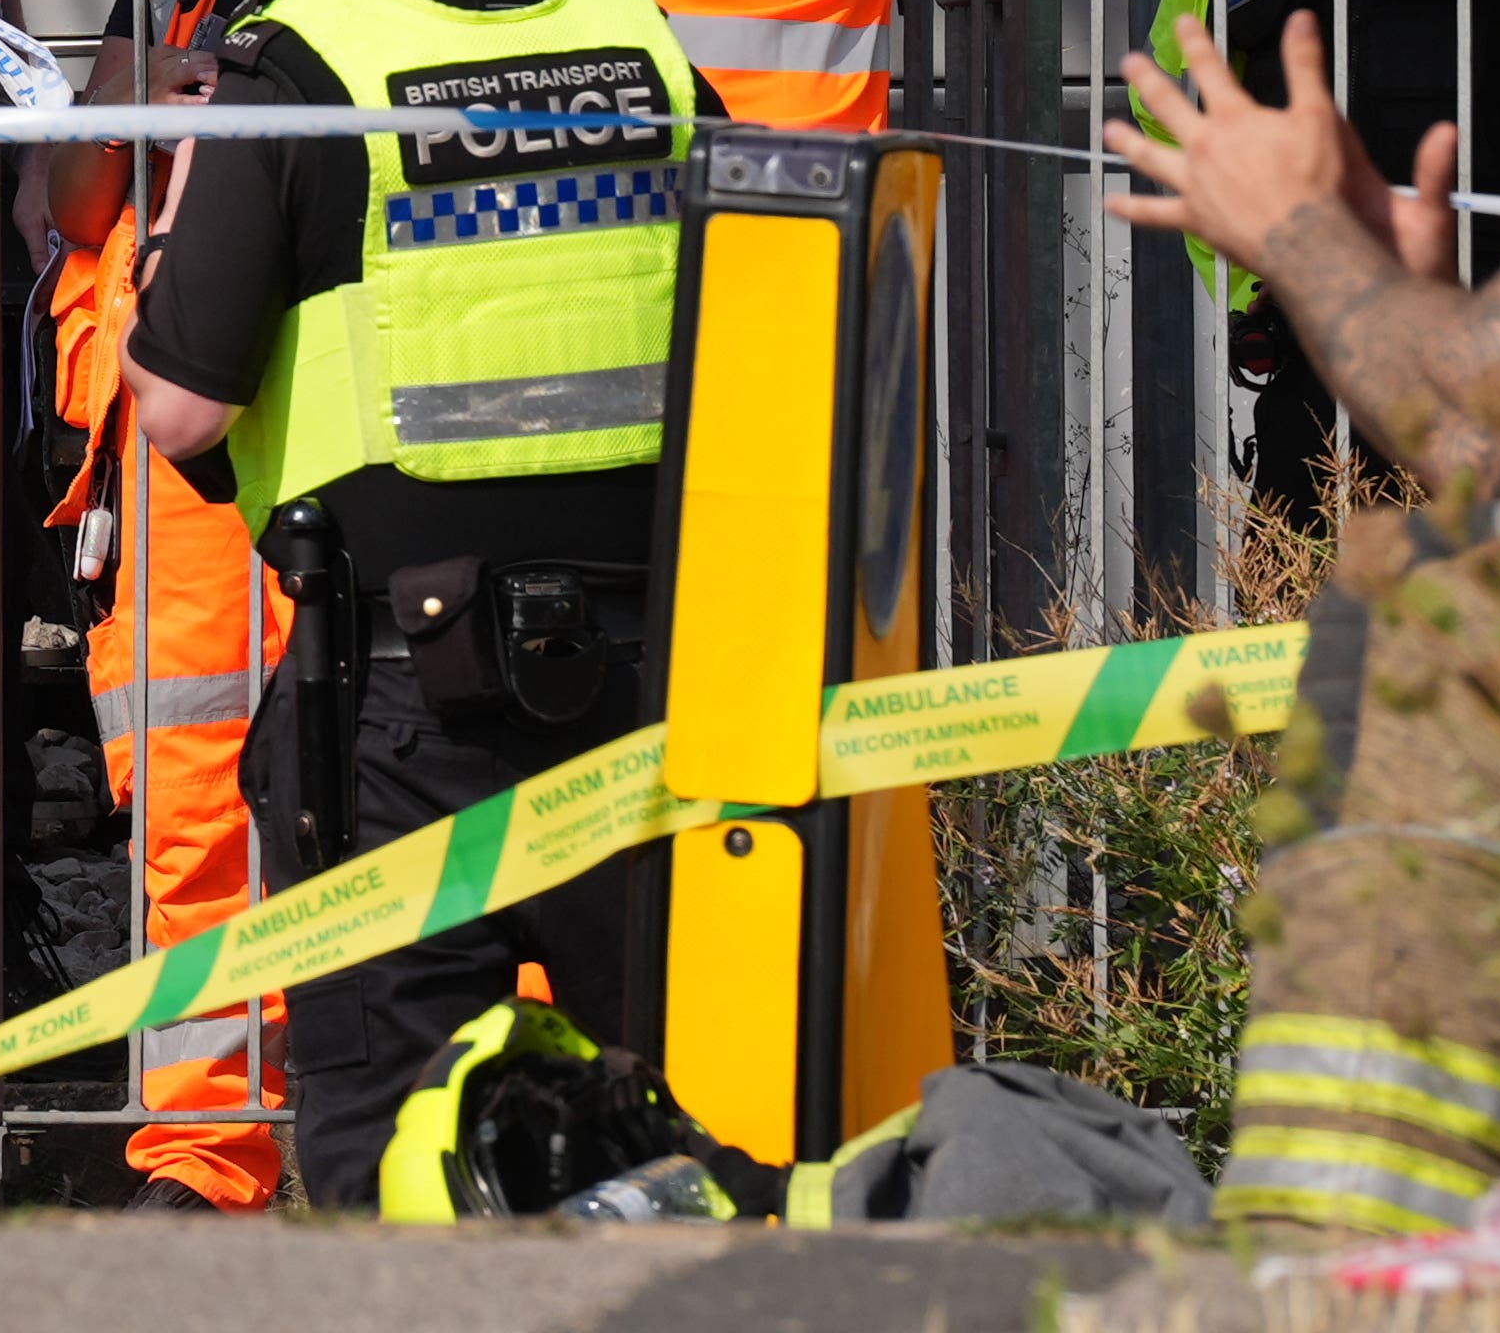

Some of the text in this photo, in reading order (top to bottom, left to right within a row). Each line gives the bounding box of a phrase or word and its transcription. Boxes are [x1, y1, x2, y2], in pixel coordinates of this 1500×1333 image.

[405, 61, 642, 105] BRITISH TRANSPORT
[1198, 639, 1286, 669] WARM
[845, 675, 1020, 721] AMBULANCE
[835, 710, 1039, 756] DECONTAMINATION
[914, 746, 971, 770] AREA
[529, 769, 605, 817] WARM
[236, 866, 384, 950] AMBULANCE
[228, 898, 406, 982] DECONTAMINATION
[291, 946, 344, 975] AREA
[26, 1003, 92, 1046] ZONE
